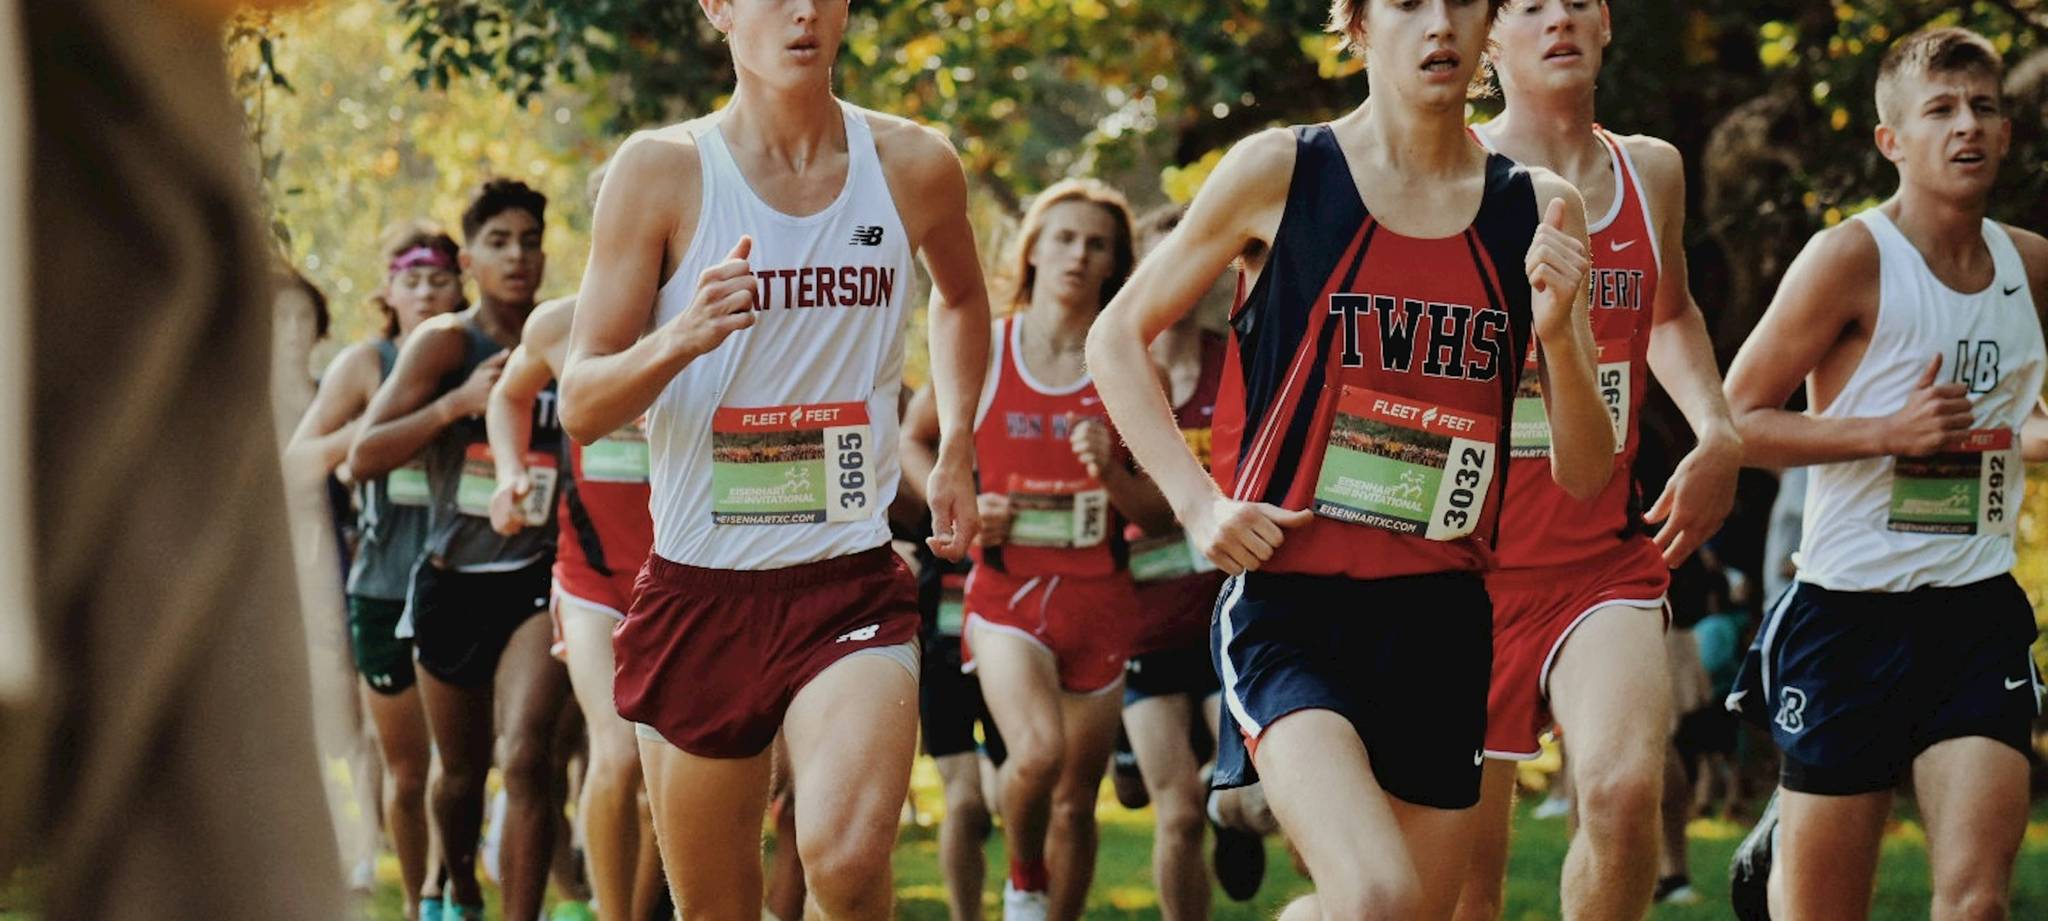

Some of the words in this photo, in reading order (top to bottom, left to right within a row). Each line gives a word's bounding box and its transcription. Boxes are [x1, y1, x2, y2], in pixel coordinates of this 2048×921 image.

[749, 266, 895, 311] TTERSON
[1329, 293, 1509, 383] TWHS
[742, 412, 787, 426] FLEET
[806, 408, 840, 422] FEET
[1372, 399, 1420, 420] FLEET
[1438, 414, 1476, 431] FEET
[837, 432, 867, 509] 3665
[1443, 447, 1486, 529] 3032
[1987, 456, 2006, 522] 3292
[1319, 503, 1418, 532] EISENHARTXC.COM
